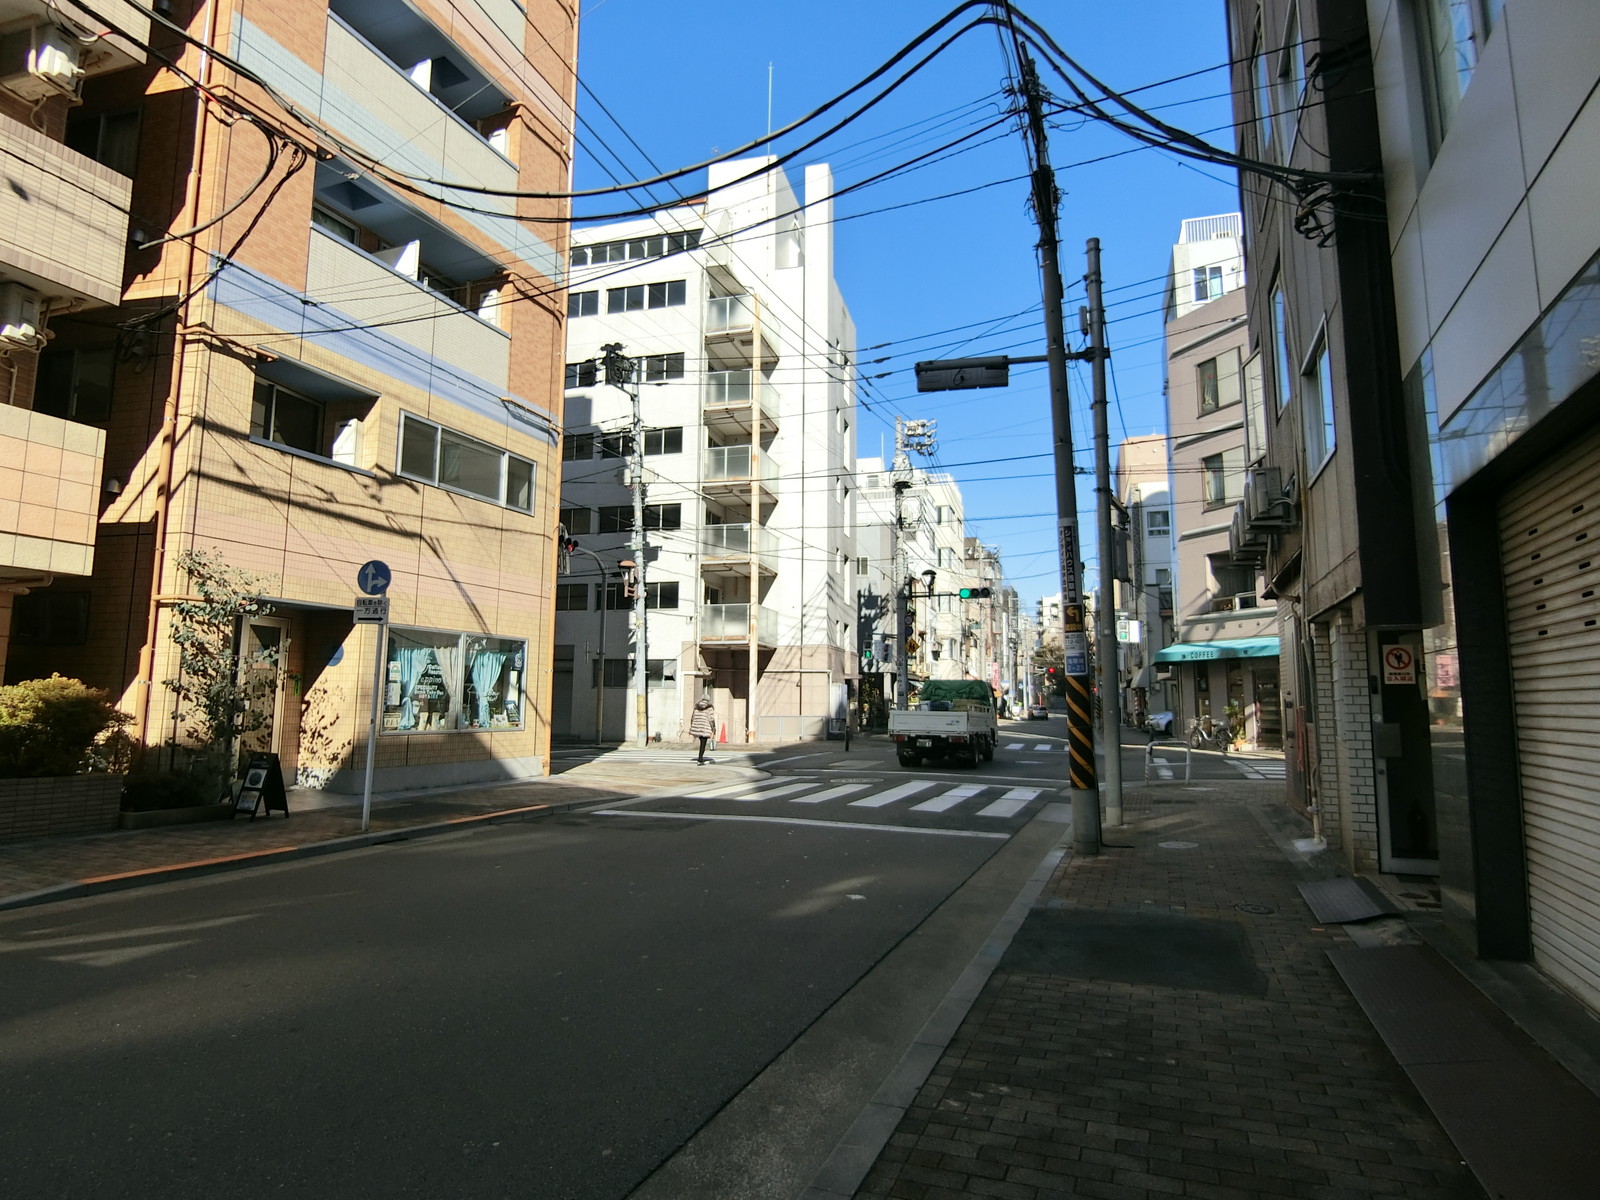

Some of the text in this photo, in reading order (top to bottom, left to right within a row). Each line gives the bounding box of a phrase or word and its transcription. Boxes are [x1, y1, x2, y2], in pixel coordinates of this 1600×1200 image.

[356, 607, 387, 615] 一方通行
[1190, 650, 1214, 659] COFFEE
